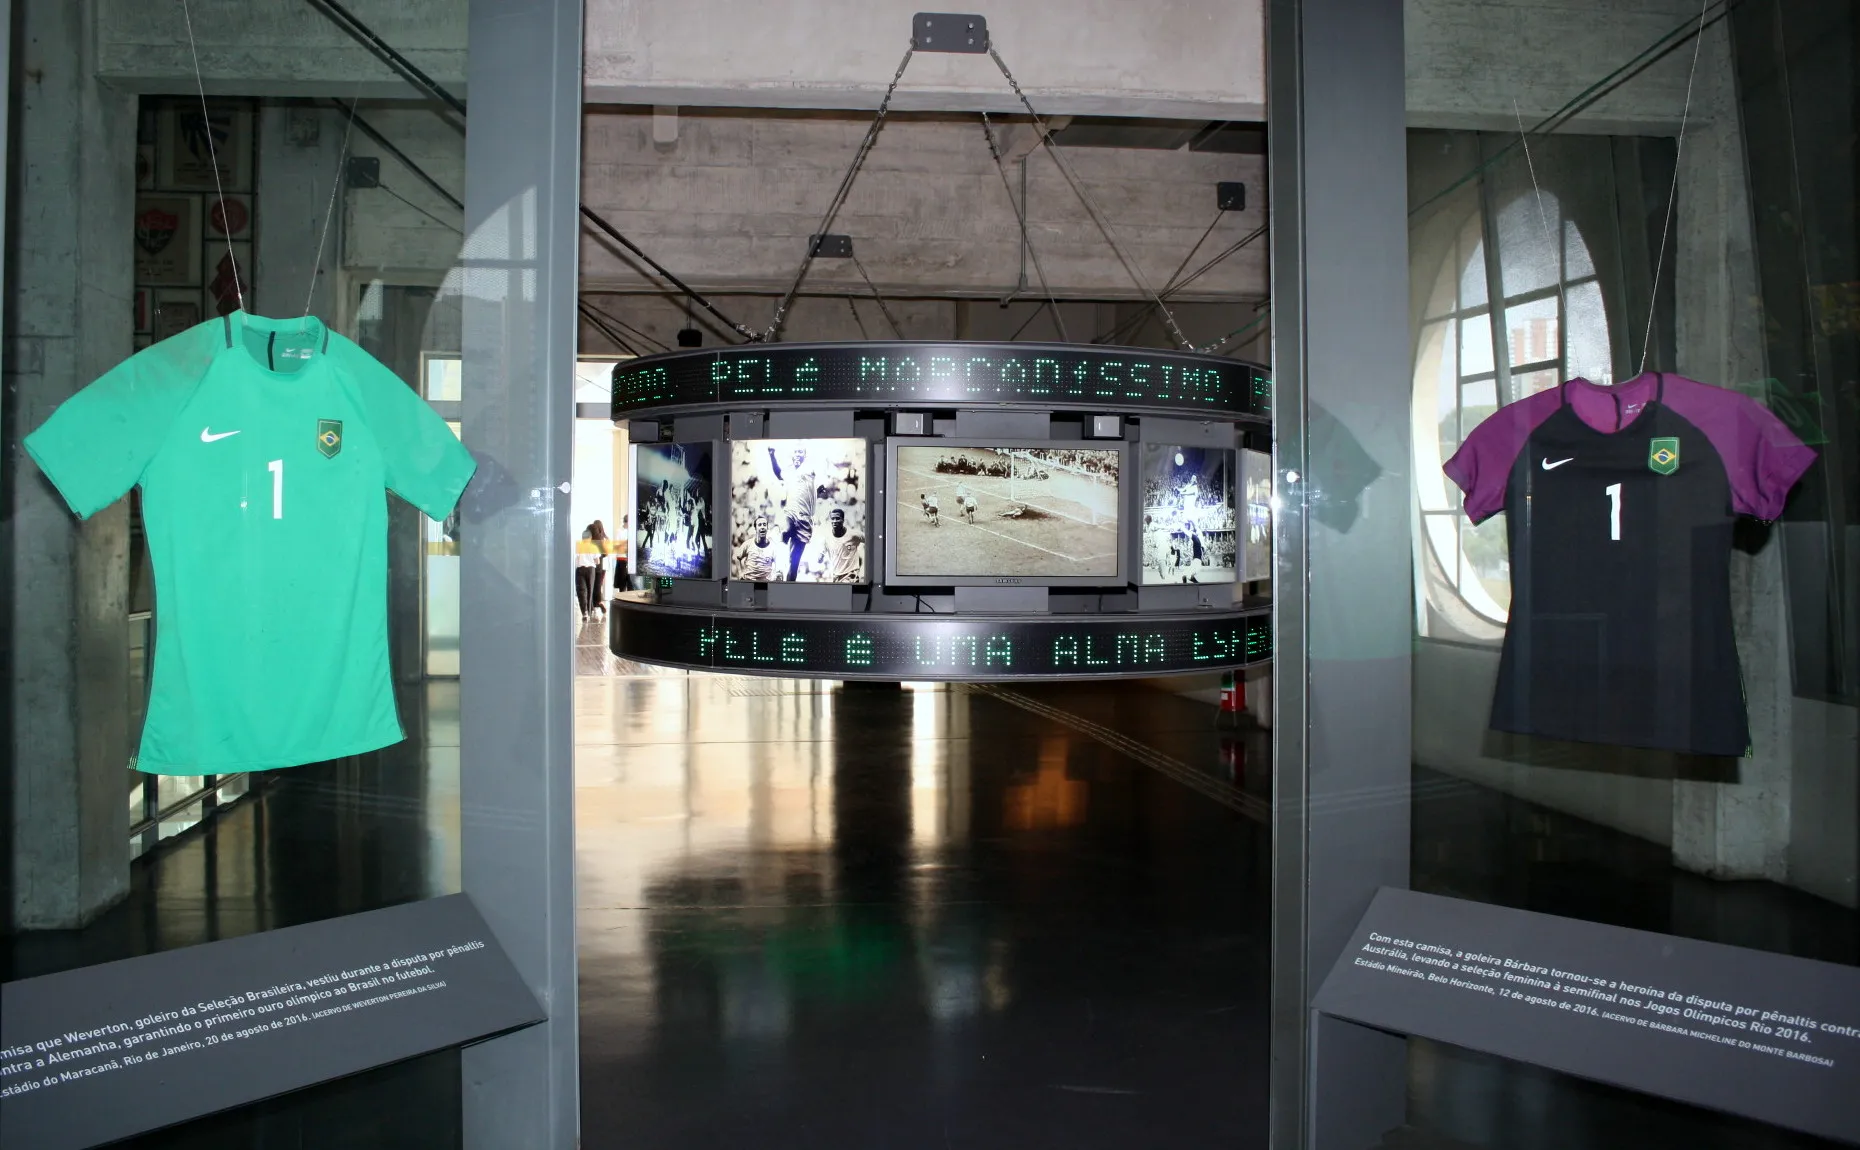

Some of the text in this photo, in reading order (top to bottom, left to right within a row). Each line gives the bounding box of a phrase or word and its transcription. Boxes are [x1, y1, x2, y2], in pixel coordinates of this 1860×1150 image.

[268, 459, 284, 520] 1
[1605, 482, 1622, 541] 1
[915, 635, 1012, 666] UMA
[1053, 633, 1165, 666] ALMA
[0, 965, 435, 1076] ntra a Alemanha, garantindo o primeiro ouro olímpico ao Brasil no futebol.
[36, 1038, 63, 1052] que
[63, 1022, 134, 1043] Weverton,
[135, 1011, 179, 1030] goleiro
[181, 1006, 197, 1017] da
[197, 995, 245, 1013] Seleção
[245, 983, 307, 1002] Brasileira,
[305, 973, 340, 988] vestiu
[340, 965, 382, 980] durante
[391, 954, 428, 968] disputa
[428, 950, 445, 962] por
[446, 940, 485, 958] pênaltis
[1354, 957, 1386, 970] Estádio
[1386, 964, 1425, 980] Mineirão,
[1427, 972, 1449, 984] Belo
[1449, 977, 1495, 995] Horizonte,
[1499, 988, 1511, 998] 12
[1511, 991, 1524, 1000] de
[1524, 995, 1558, 1008] agosto
[1558, 1001, 1572, 1011] de
[1572, 1003, 1600, 1017] 2016.
[1636, 1018, 1649, 1027] DE
[1648, 1021, 1689, 1036] BÁRBARA
[1689, 1030, 1738, 1046] MICHELINE
[1737, 1040, 1752, 1049] DO
[1752, 1043, 1785, 1057] MONTE
[1361, 943, 1408, 961] Austrália,
[1411, 952, 1451, 968] levando
[1460, 964, 1502, 979] seleção
[1502, 971, 1552, 989] feminina
[1552, 981, 1561, 991] à
[1562, 985, 1618, 1003] semifinal
[1619, 997, 1642, 1008] nos
[1643, 1000, 1681, 1016] Jogos
[1683, 1008, 1747, 1029] Olímpicos
[1749, 1021, 1772, 1035] Rio
[1774, 1026, 1812, 1043] 2016.
[1369, 932, 1392, 944] Com
[1393, 938, 1415, 948] esta
[1415, 943, 1453, 957] camisa,
[1455, 950, 1463, 958] a
[1463, 952, 1502, 966] goleira
[1503, 958, 1549, 975] Bárbara
[1550, 968, 1607, 987] tornou-se
[1608, 981, 1617, 989] a
[1619, 980, 1665, 999] heroína
[1667, 991, 1684, 1002] da
[1685, 994, 1733, 1012] disputa
[1734, 1006, 1760, 1017] por
[1760, 1010, 1817, 1029] pênaltis
[0, 1080, 41, 1098] stádio
[43, 1076, 59, 1087] do
[59, 1059, 123, 1082] Maracanã,
[123, 1054, 143, 1066] Rio
[145, 1051, 160, 1061] de
[162, 1041, 205, 1057] Janeiro,
[205, 1034, 219, 1046] 20
[220, 1032, 235, 1042] de
[235, 1024, 270, 1039] agosto
[270, 1020, 284, 1029] de
[283, 1013, 312, 1026] 2016.
[341, 1003, 353, 1012] DE
[351, 994, 390, 1009] WEVERTON
[388, 988, 418, 1000] PEREIRA
